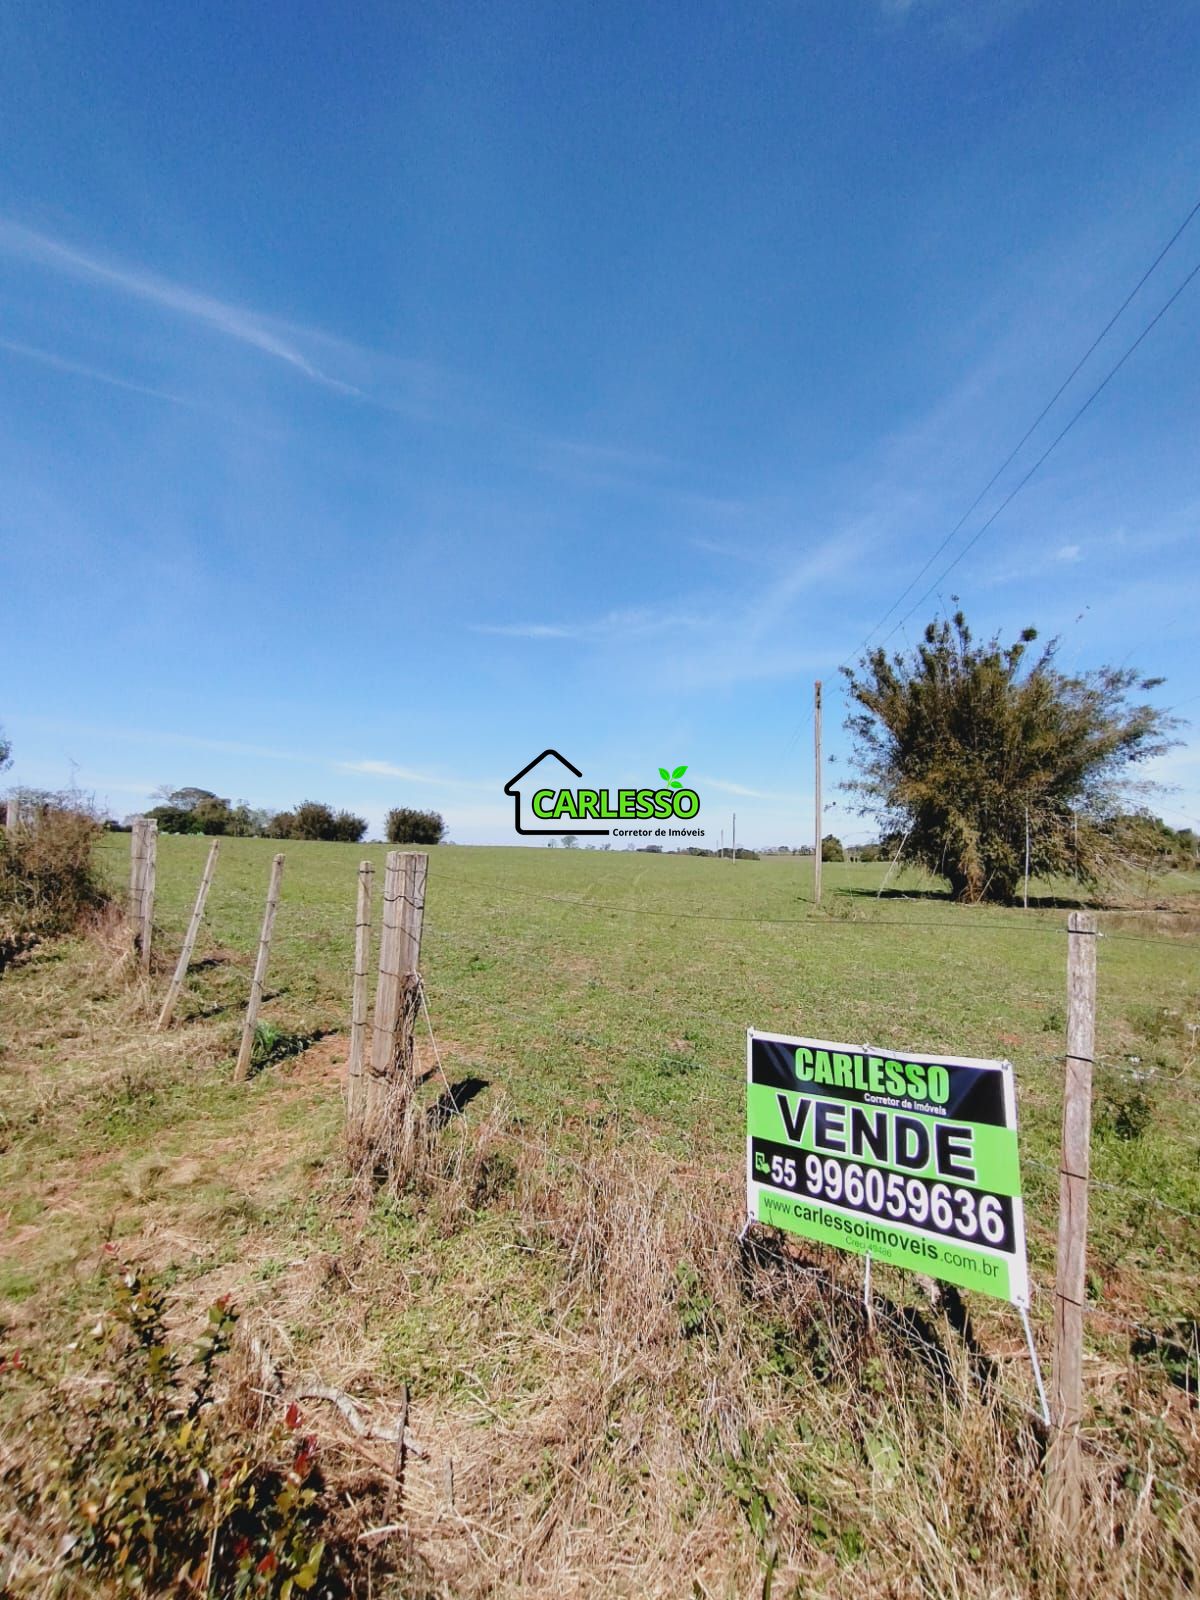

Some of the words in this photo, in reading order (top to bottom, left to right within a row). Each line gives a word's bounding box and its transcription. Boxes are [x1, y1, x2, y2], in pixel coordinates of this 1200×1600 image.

[795, 1048, 949, 1104] CARLESSO
[863, 1092, 901, 1107] Corretor
[901, 1099, 913, 1110] de
[776, 1093, 977, 1184] VENDE
[764, 1196, 999, 1278] www.carlessoimoveis.com.br
[771, 1155, 797, 1187] 55
[805, 1155, 1005, 1243] 996059636
